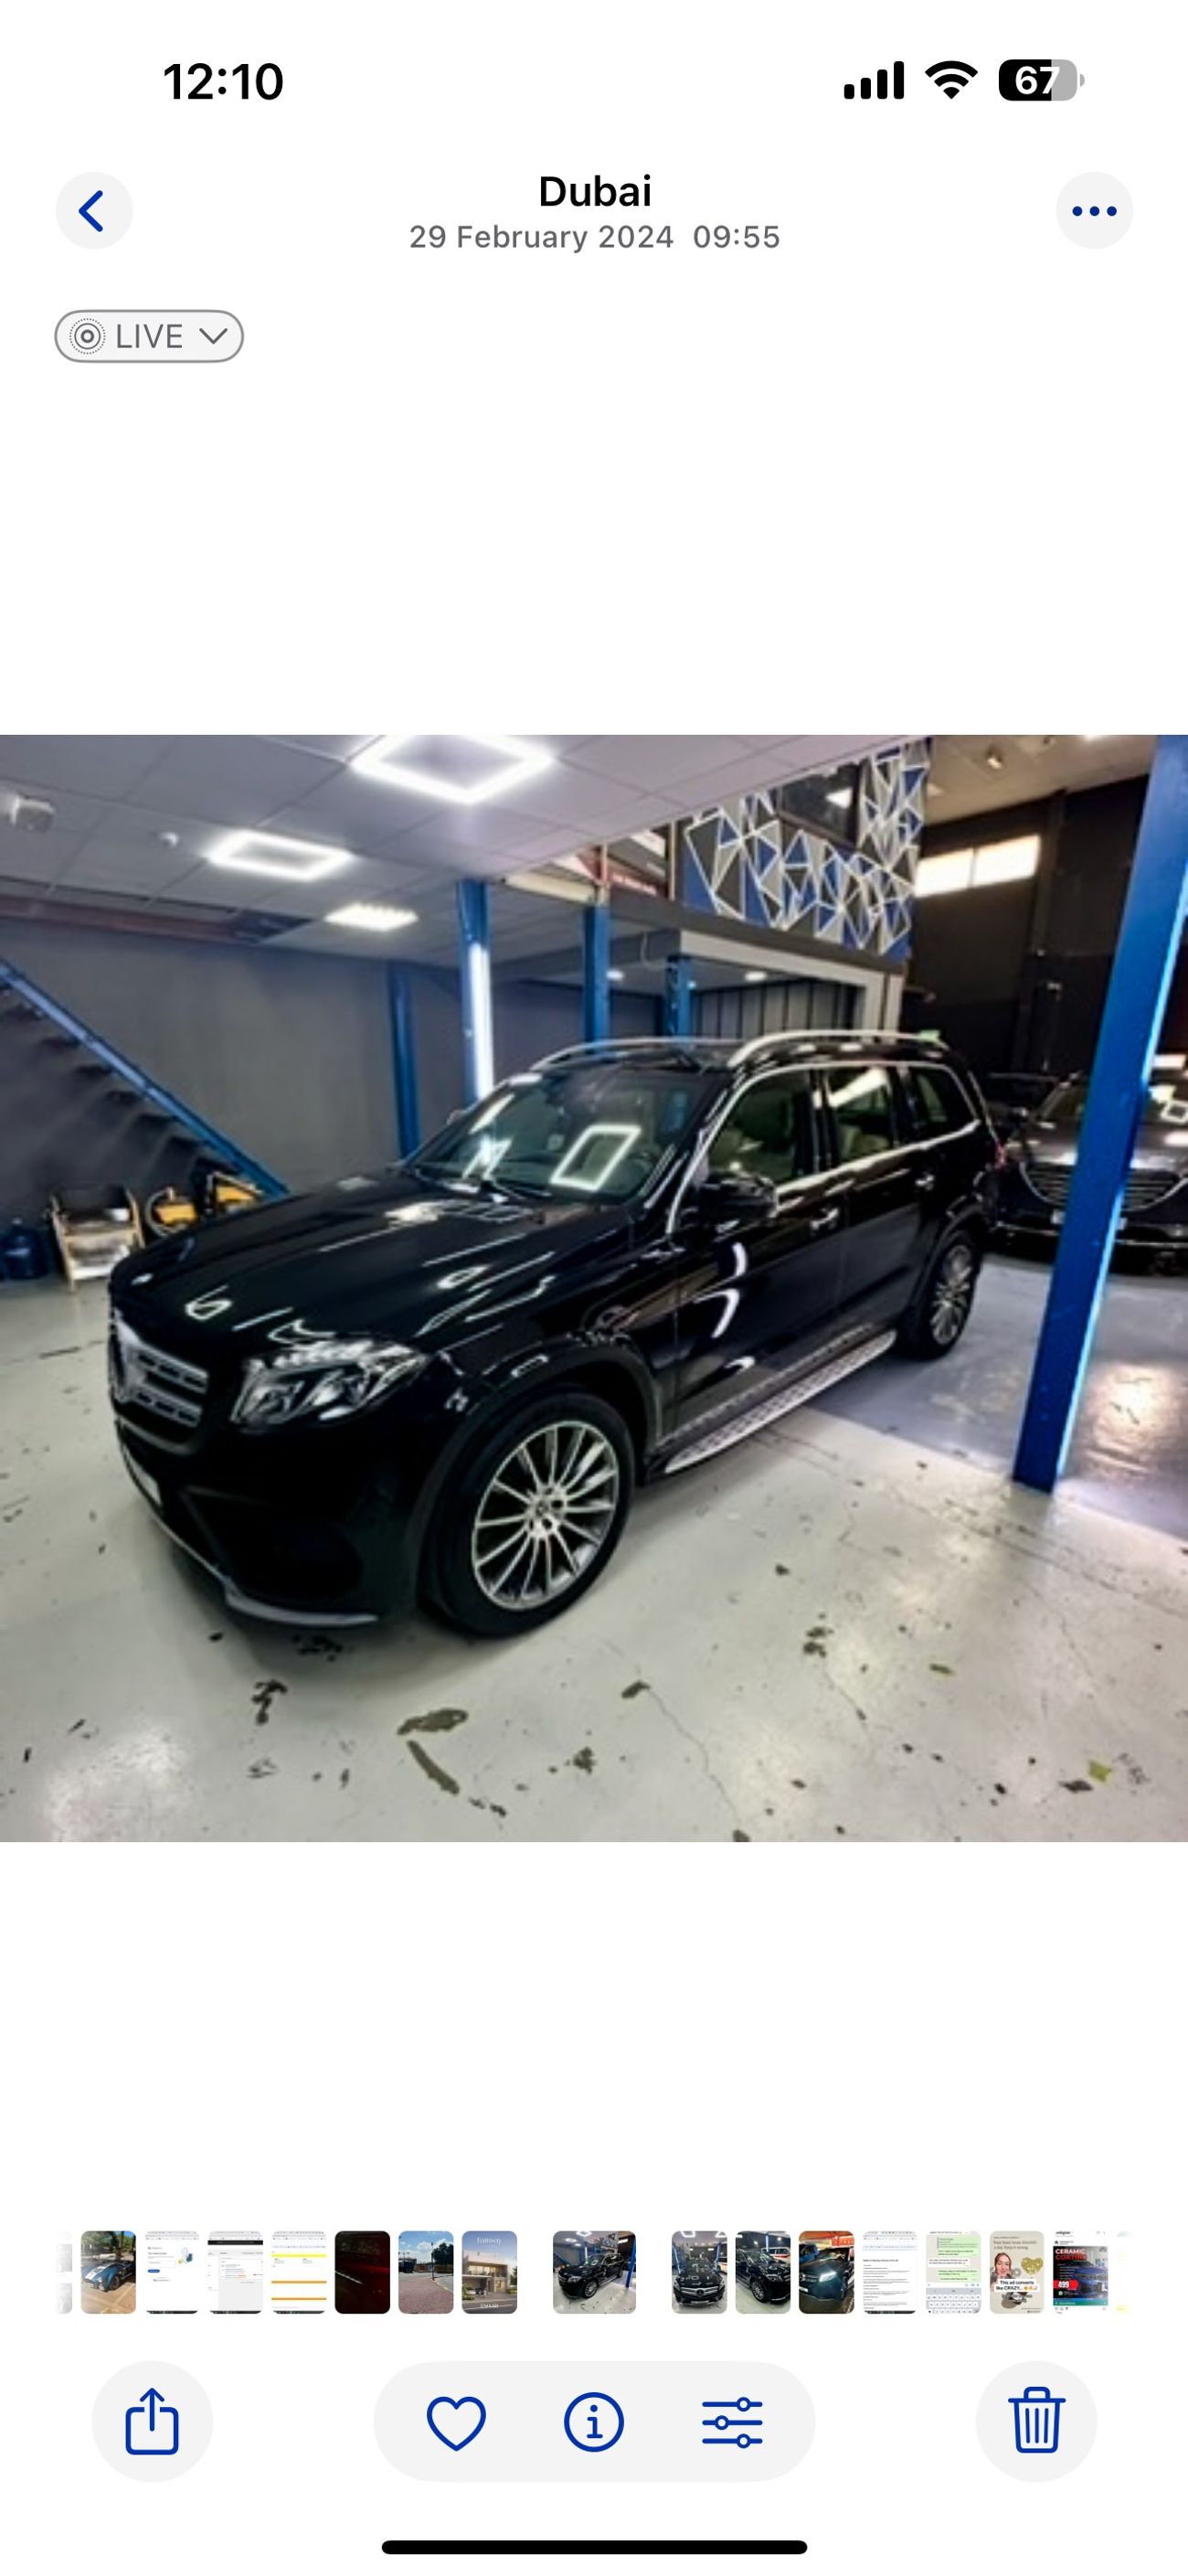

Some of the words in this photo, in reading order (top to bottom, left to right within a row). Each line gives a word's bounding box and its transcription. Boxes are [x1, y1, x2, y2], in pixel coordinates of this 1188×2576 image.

[164, 63, 283, 101] 12:10
[1015, 66, 1060, 94] 67
[541, 174, 651, 207] Dubai
[410, 225, 445, 248] 29
[458, 225, 588, 253] February
[599, 225, 674, 248] 2024
[694, 225, 780, 248] 09:55
[116, 324, 183, 348] LIVE
